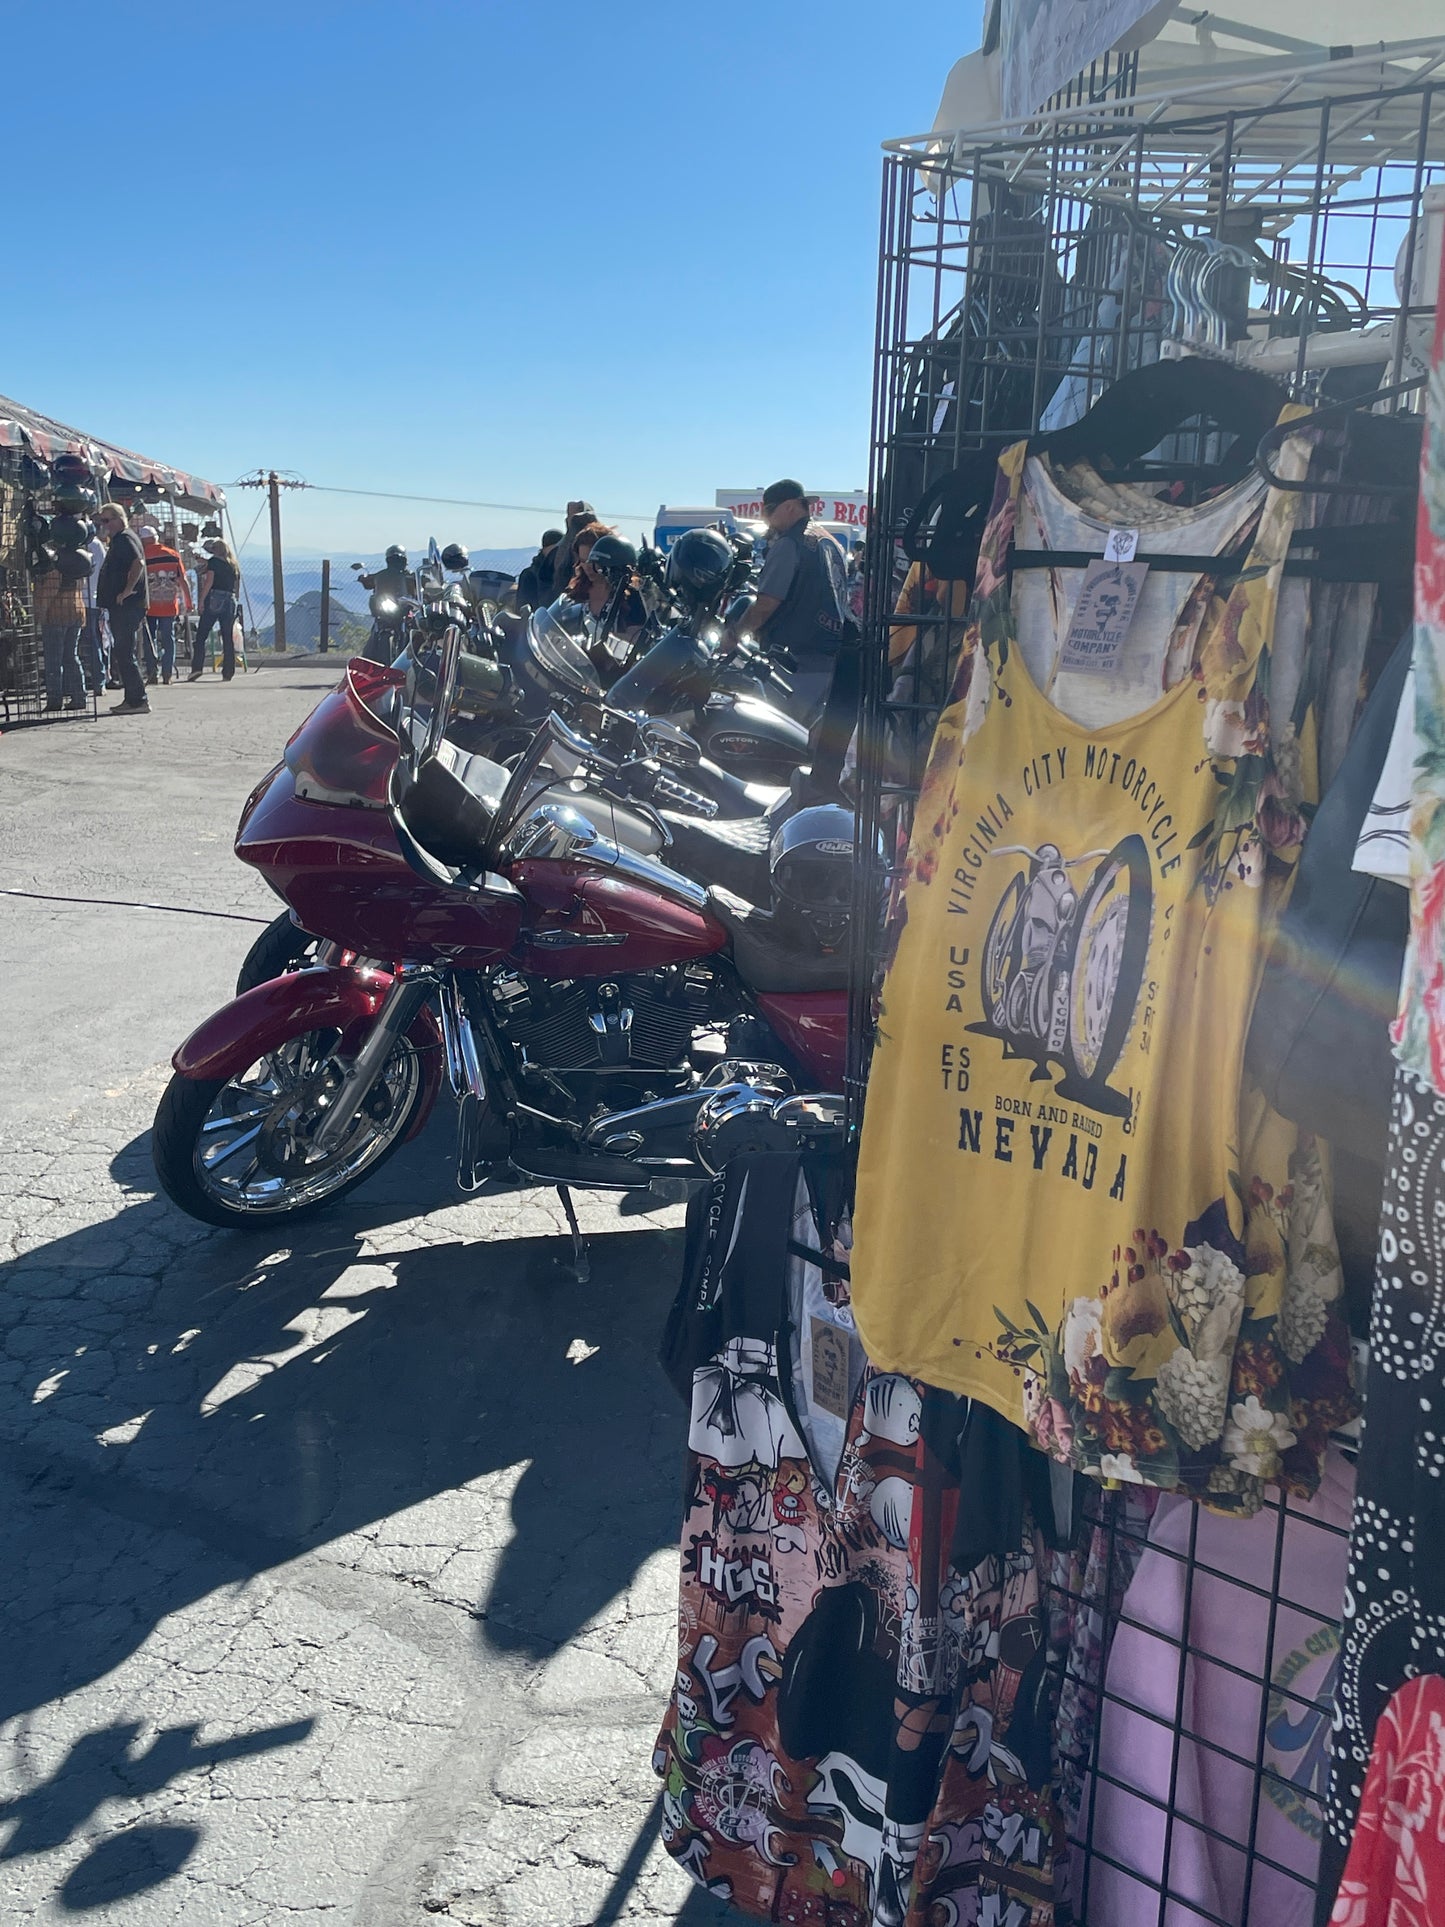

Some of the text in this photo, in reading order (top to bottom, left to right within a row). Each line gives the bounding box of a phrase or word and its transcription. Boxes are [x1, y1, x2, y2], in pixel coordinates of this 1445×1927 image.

[1067, 639, 1119, 655] COMPANY
[719, 736, 760, 745] VICTORY
[946, 793, 1015, 915] VIRGINIA
[1023, 746, 1067, 797] CITY
[1084, 744, 1182, 879] MOTORCYCLE
[945, 945, 970, 1013] USA
[995, 1095, 1103, 1139] BORN AND RAISED
[958, 1107, 1128, 1202] NEVADA
[709, 1170, 727, 1241] RCYCLE
[700, 1546, 775, 1605] HGS
